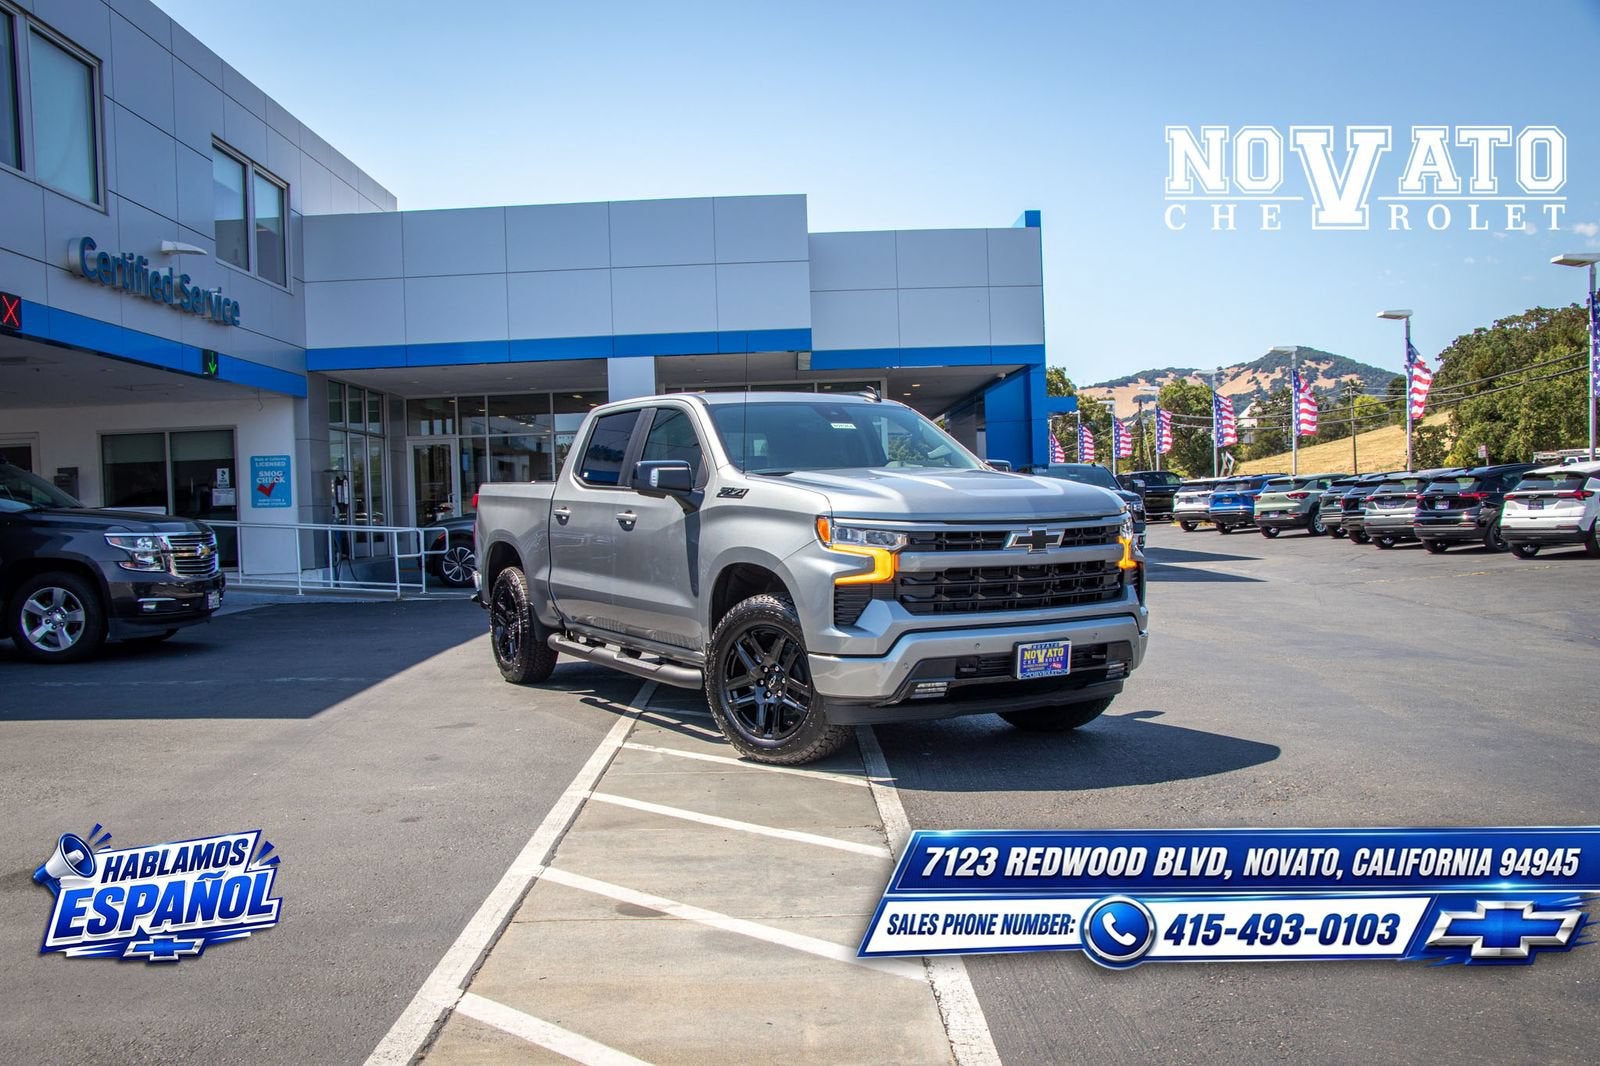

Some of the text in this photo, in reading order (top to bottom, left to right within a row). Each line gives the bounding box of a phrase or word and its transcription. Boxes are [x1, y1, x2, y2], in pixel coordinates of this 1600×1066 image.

[79, 236, 241, 326] Certified Service
[1024, 648, 1064, 663] NOVATO
